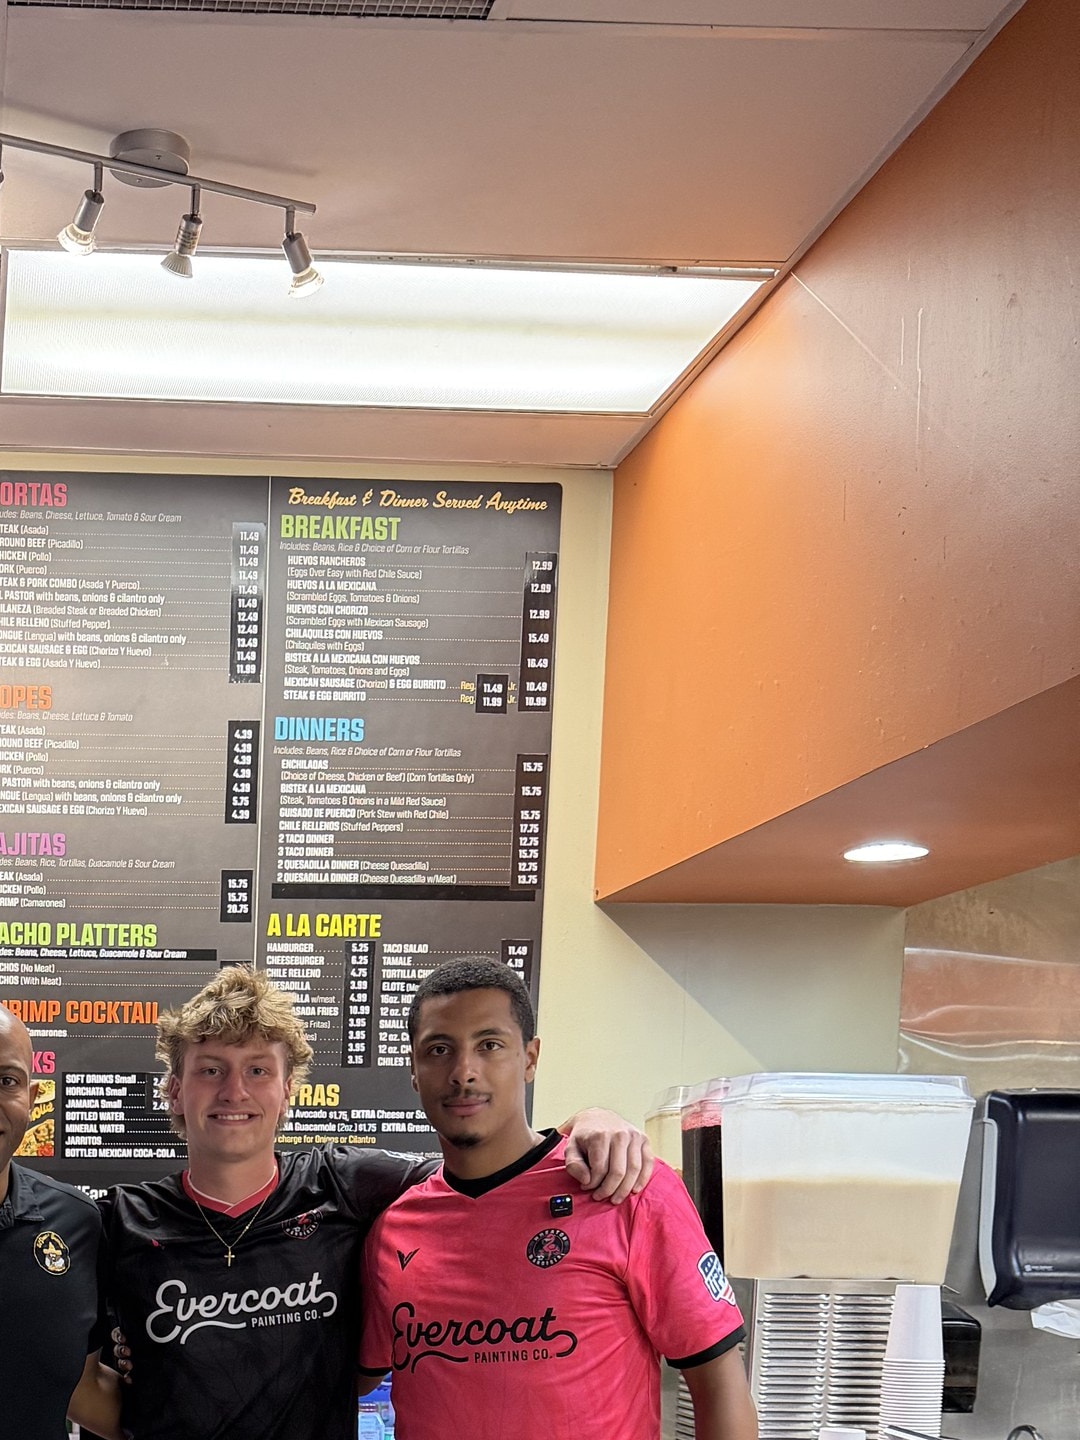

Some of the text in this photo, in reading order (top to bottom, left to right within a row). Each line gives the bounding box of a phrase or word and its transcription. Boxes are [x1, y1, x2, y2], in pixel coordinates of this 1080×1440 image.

[288, 488, 548, 514] Breakfast & Dinner Served Anytime
[280, 514, 401, 540] BREAKFAST
[287, 556, 366, 566] HUEVOS RANCHEROS
[287, 581, 377, 591] HUEVOS A LA MEXICANA
[286, 604, 368, 615] HUEVOS CON CHORIZO
[274, 717, 364, 742] DINNERS
[281, 759, 328, 770] ENCHILADAS
[281, 784, 366, 794] BISTEK A LA MEXICANA
[16, 872, 43, 883] (Asada)
[24, 885, 46, 896] (Pollo)
[21, 898, 66, 908] (Camarones)
[267, 914, 382, 937] A LA CARTE
[56, 923, 157, 947] PLATTERS
[267, 943, 314, 952] HAMBURGER
[383, 944, 402, 954] TACO
[266, 956, 325, 965] CHEESEBURGER
[382, 956, 412, 966] TAMALE
[21, 963, 32, 973] (No
[34, 964, 55, 974] Meat)
[266, 968, 287, 977] CHILE
[289, 969, 321, 978] RELLENO
[21, 976, 39, 986] (With
[41, 977, 62, 986] Meat)
[3, 1000, 60, 1023] RIMP
[66, 1074, 136, 1084] SOFT DRINKS Small
[65, 1087, 127, 1096] HORCHATA Small
[65, 1100, 122, 1108] JAMAICA Small
[65, 1112, 124, 1121] BOTTLED WATER
[65, 1124, 125, 1133] MINERAL WATER
[65, 1136, 102, 1145] JARRITOS
[278, 1136, 302, 1145] charge
[303, 1135, 313, 1143] for
[348, 1135, 376, 1144] Cilantro
[65, 1148, 175, 1158] BOTTLED MEXICAN COCA-COLA
[146, 1272, 337, 1344] Evercoat
[251, 1311, 321, 1328] PAINTING CO.
[392, 1301, 578, 1373] Evercoat
[474, 1349, 553, 1363] PAINTING CO.
